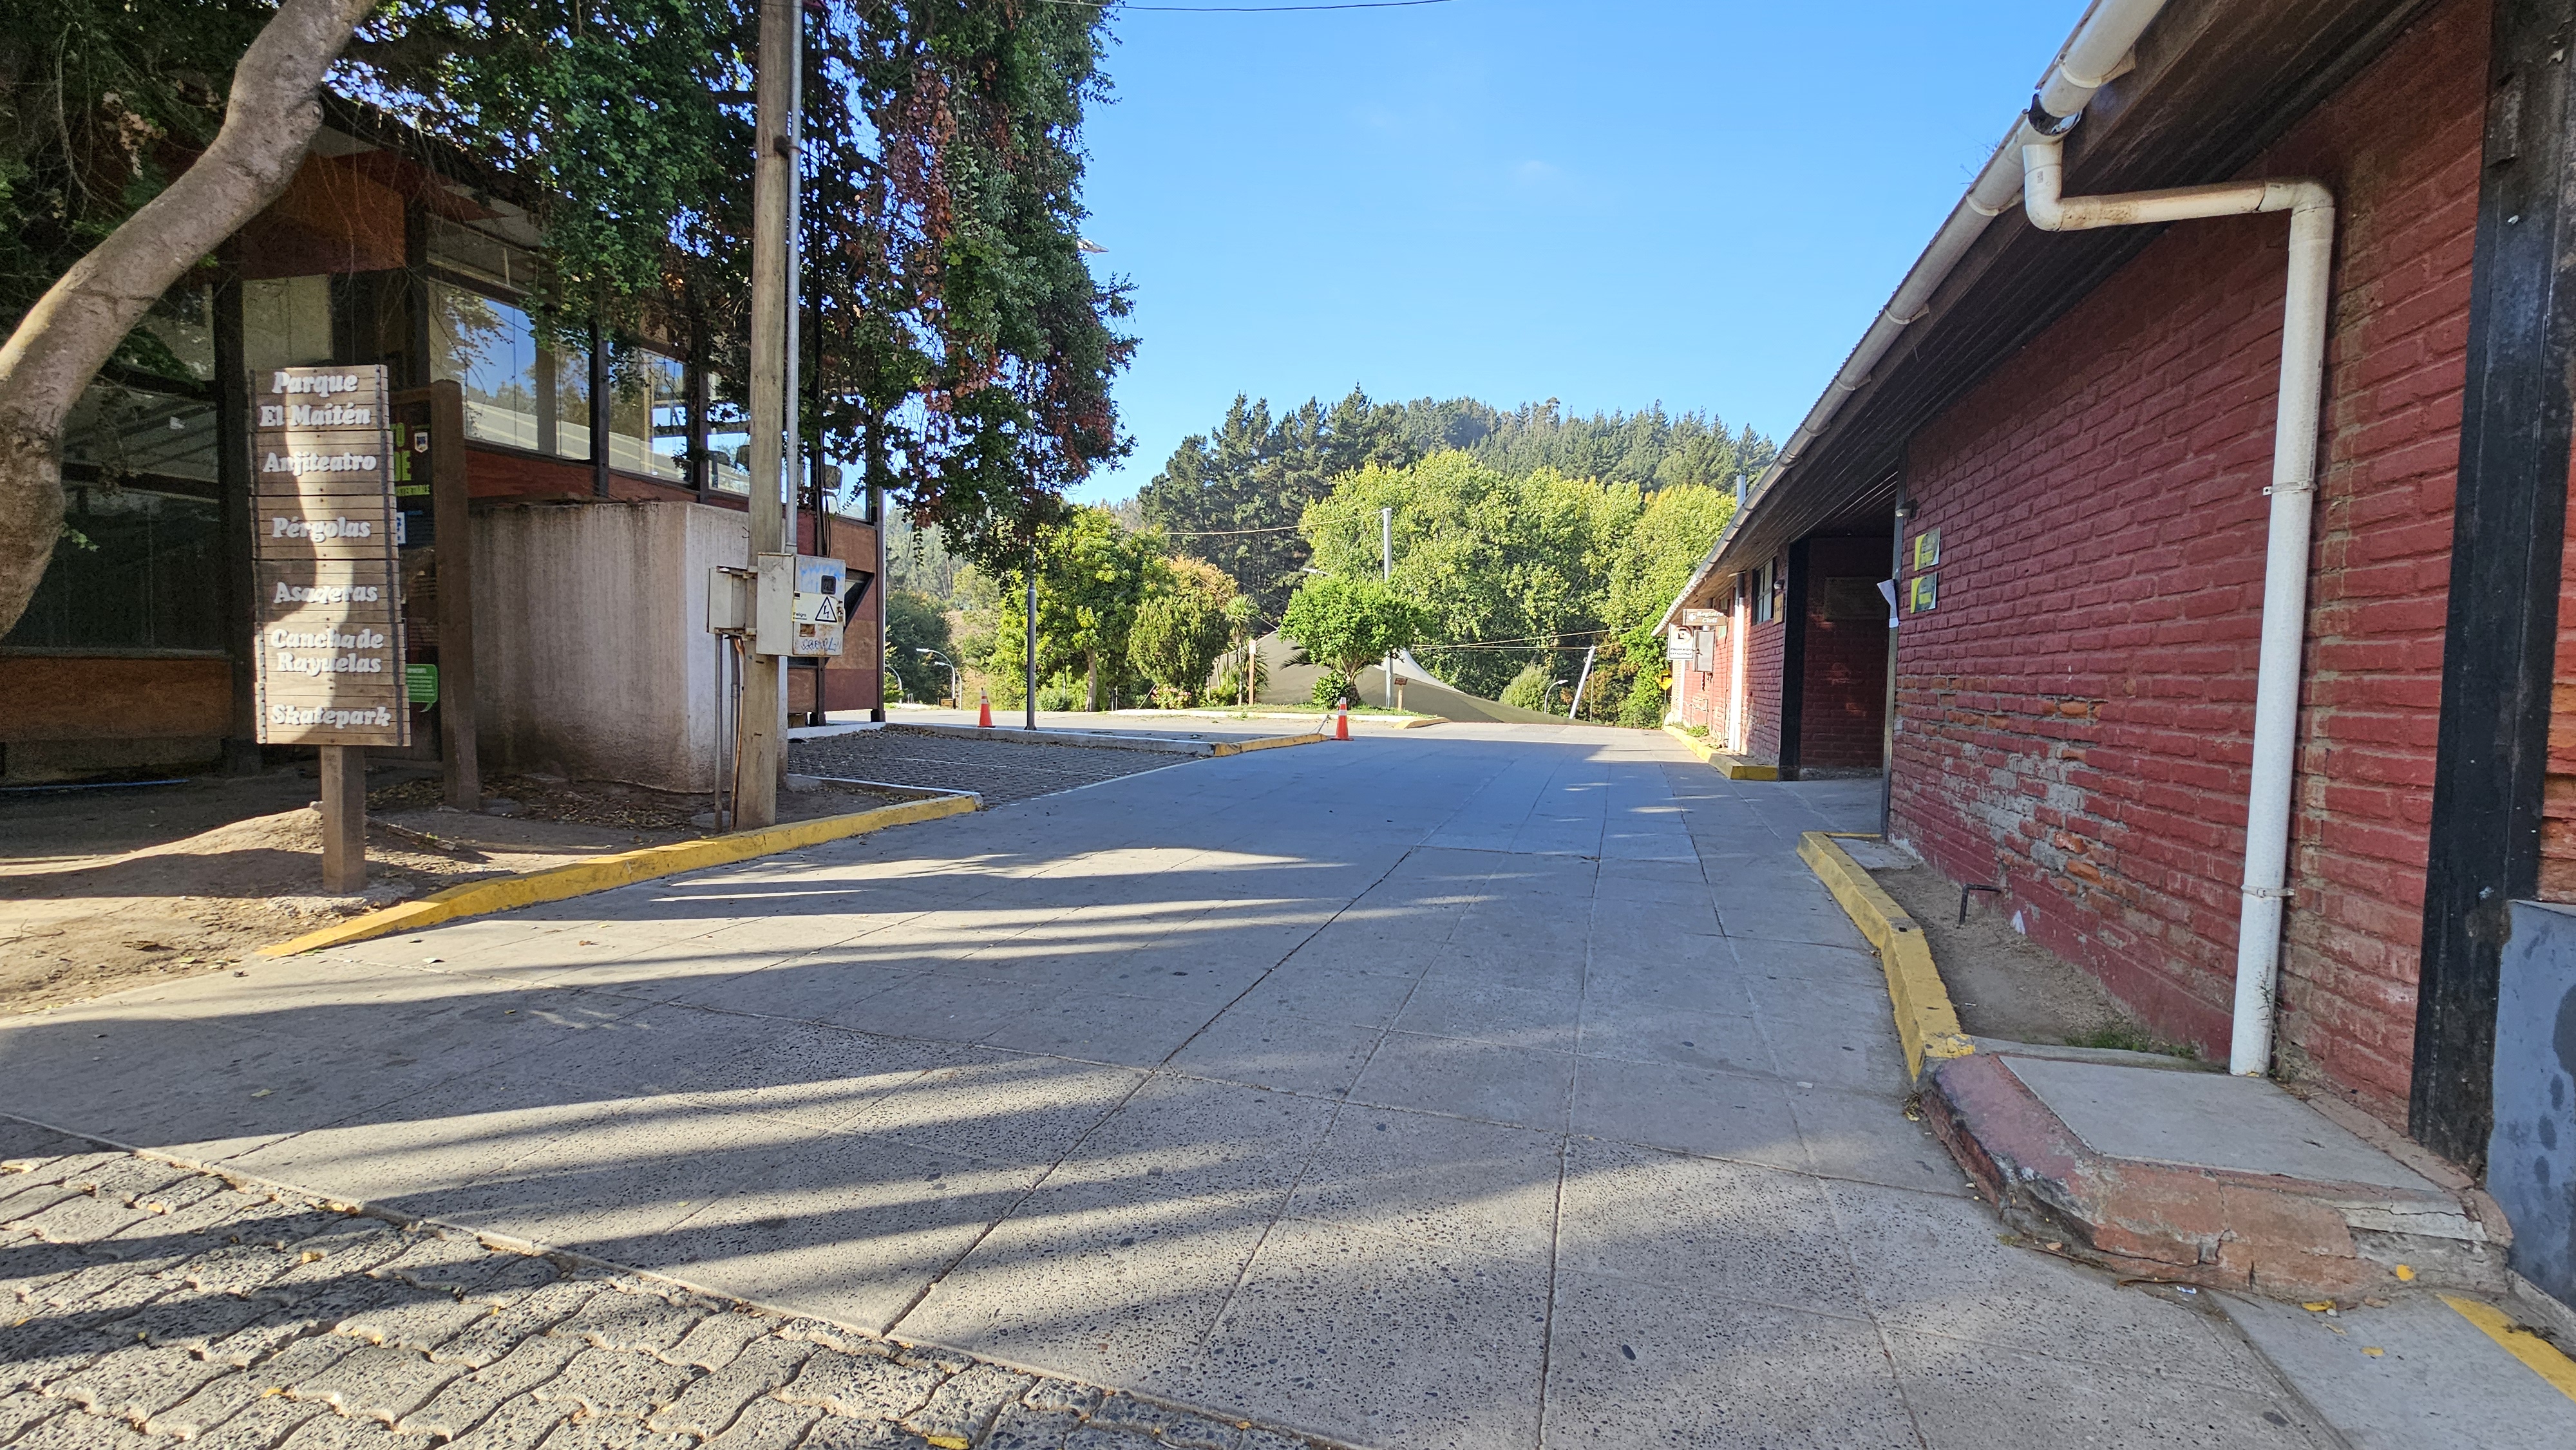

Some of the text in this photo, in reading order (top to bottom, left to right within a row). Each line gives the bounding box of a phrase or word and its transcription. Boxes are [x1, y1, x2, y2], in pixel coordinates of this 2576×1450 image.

[272, 372, 358, 397] Parque
[259, 403, 370, 427] El Maitén
[263, 452, 376, 476] Anfiteatro
[272, 517, 371, 542] Pérgolas
[274, 582, 378, 604] Asaderas
[277, 652, 381, 676] Rayuelas
[270, 704, 391, 729] Skatepark
